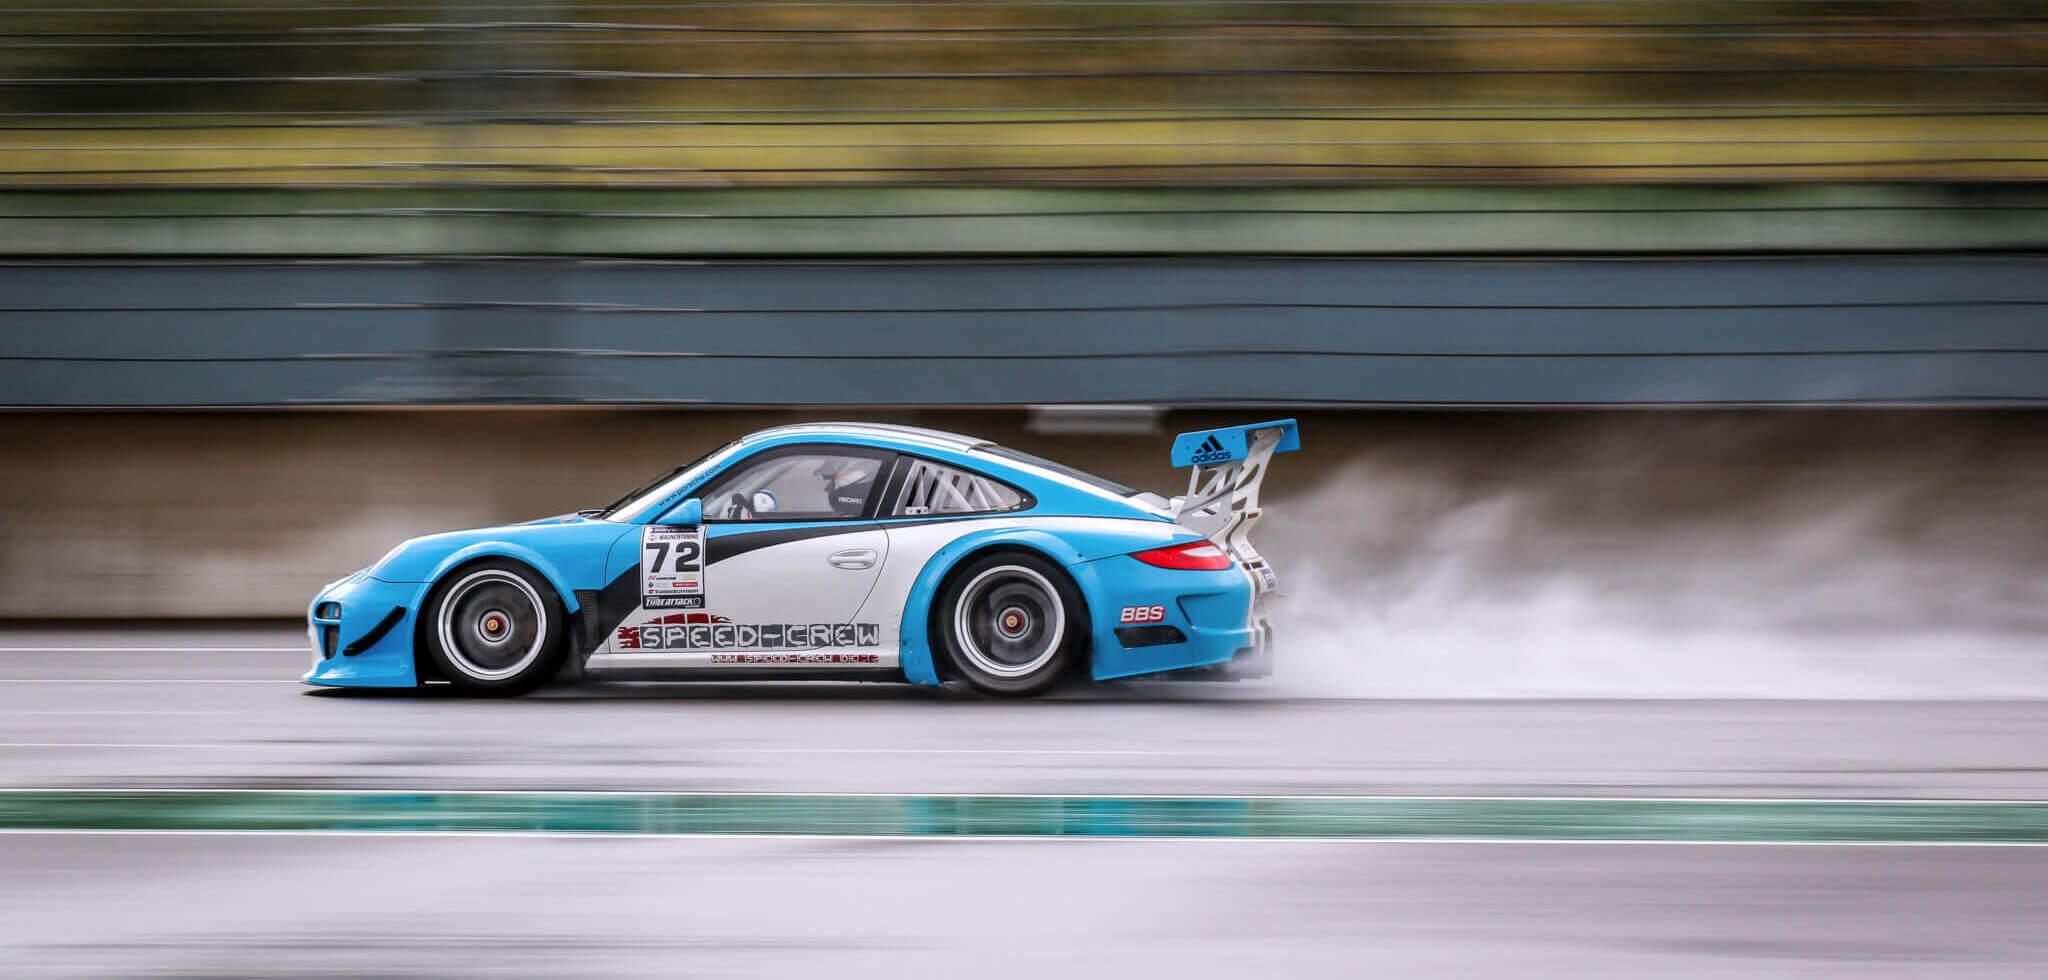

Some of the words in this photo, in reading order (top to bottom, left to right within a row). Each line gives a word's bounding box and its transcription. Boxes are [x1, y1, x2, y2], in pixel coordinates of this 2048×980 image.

[1191, 450, 1232, 464] adidas
[645, 541, 700, 573] 72
[1120, 605, 1165, 623] BBS
[641, 624, 880, 649] SPEED-CREW
